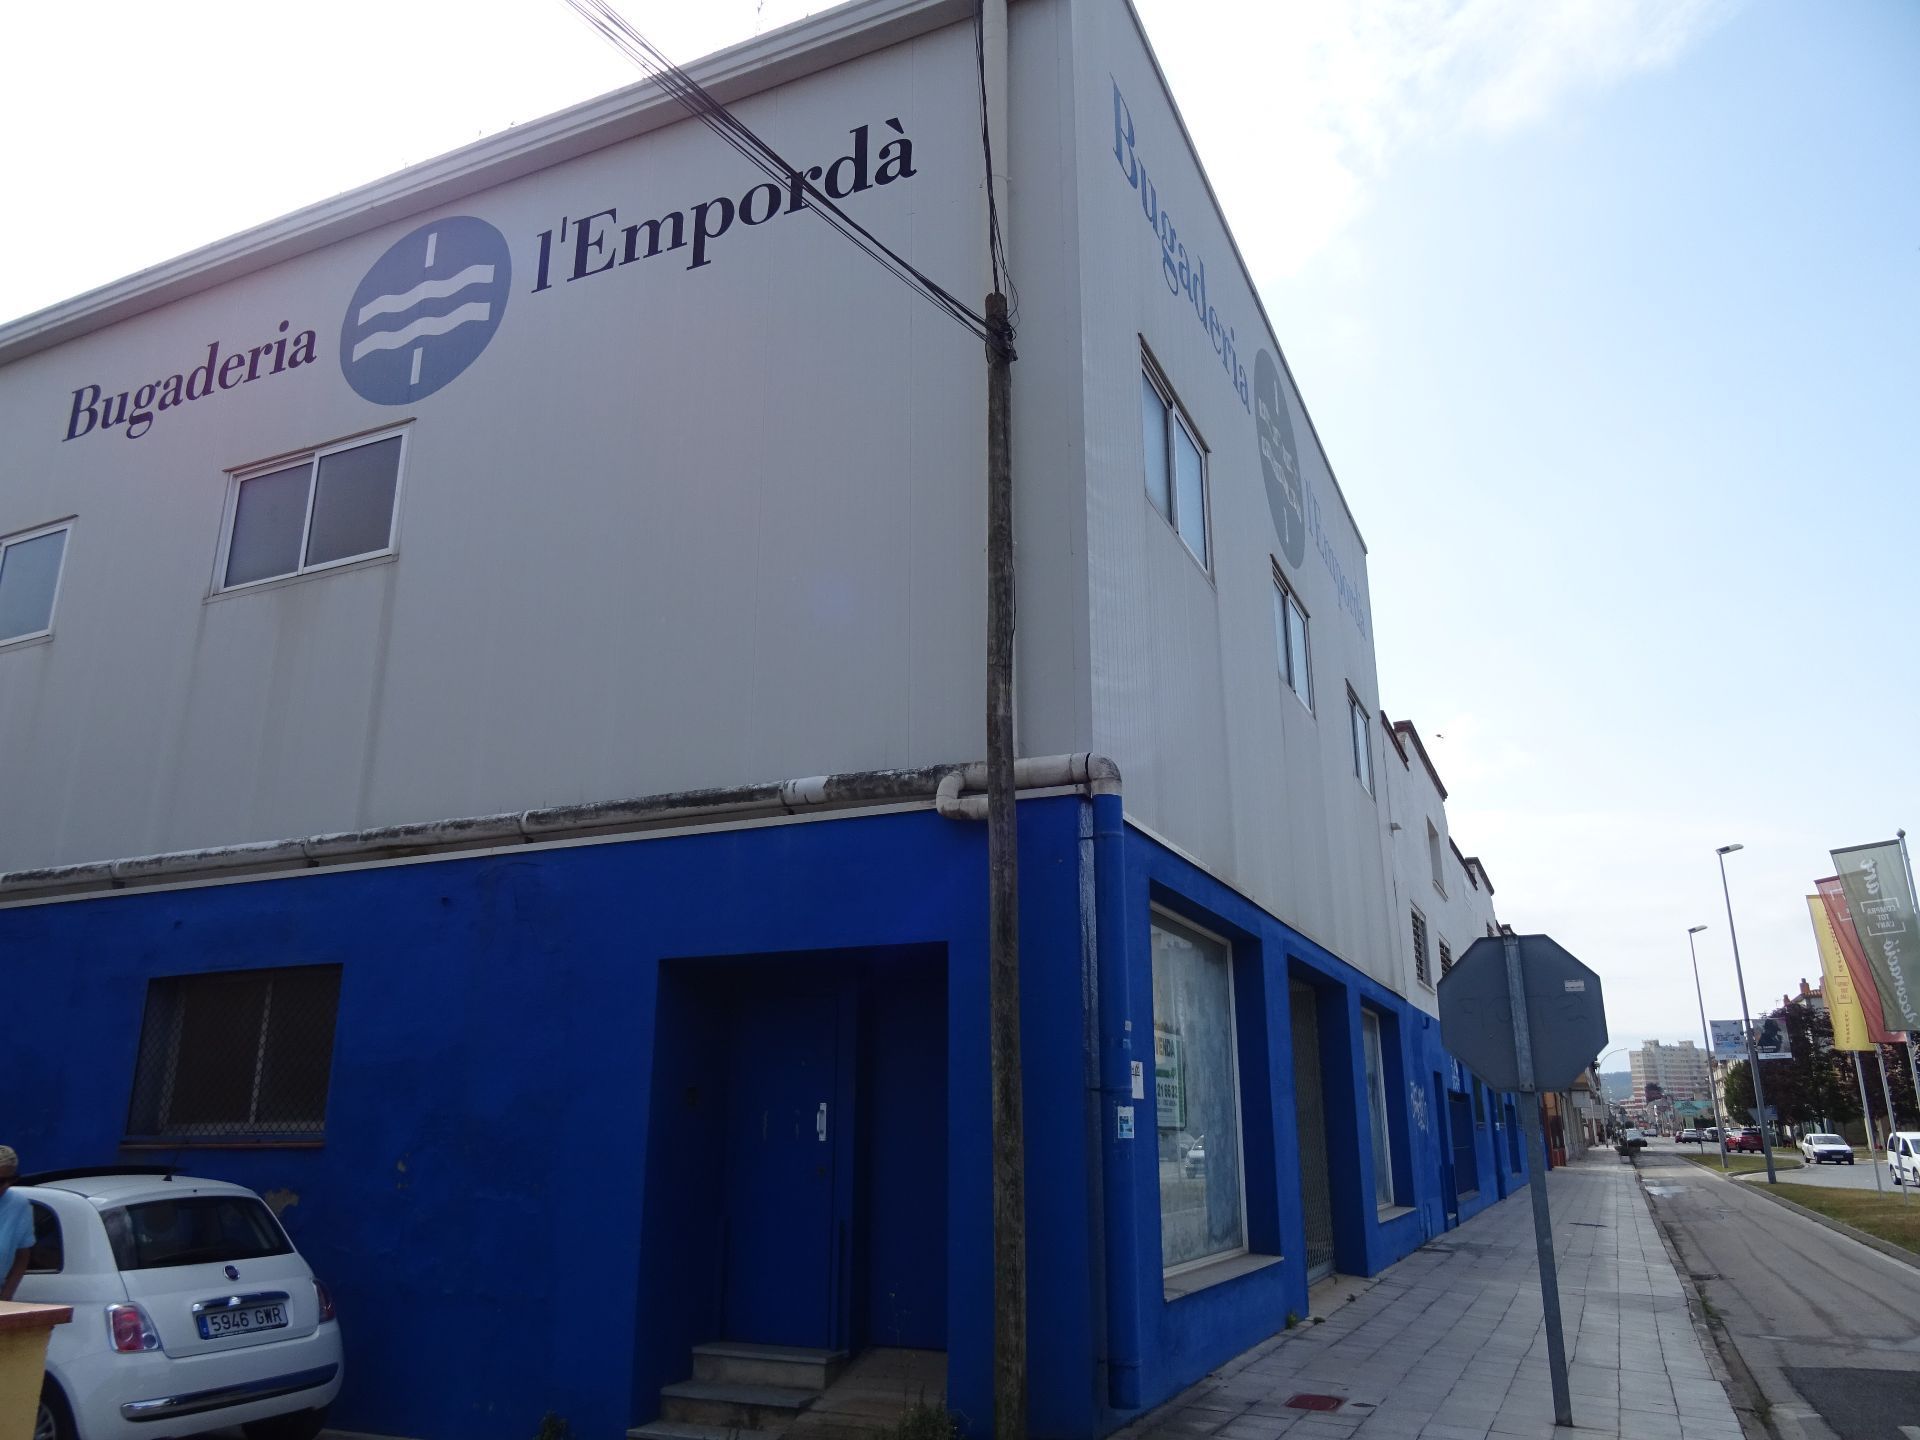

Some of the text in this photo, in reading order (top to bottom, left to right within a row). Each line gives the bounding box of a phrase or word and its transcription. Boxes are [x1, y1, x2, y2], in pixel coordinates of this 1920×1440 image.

[62, 117, 918, 442] Bugaderia l'Empordà
[1109, 71, 1251, 416] Bugaderia
[211, 1307, 282, 1331] 5946 GWR
